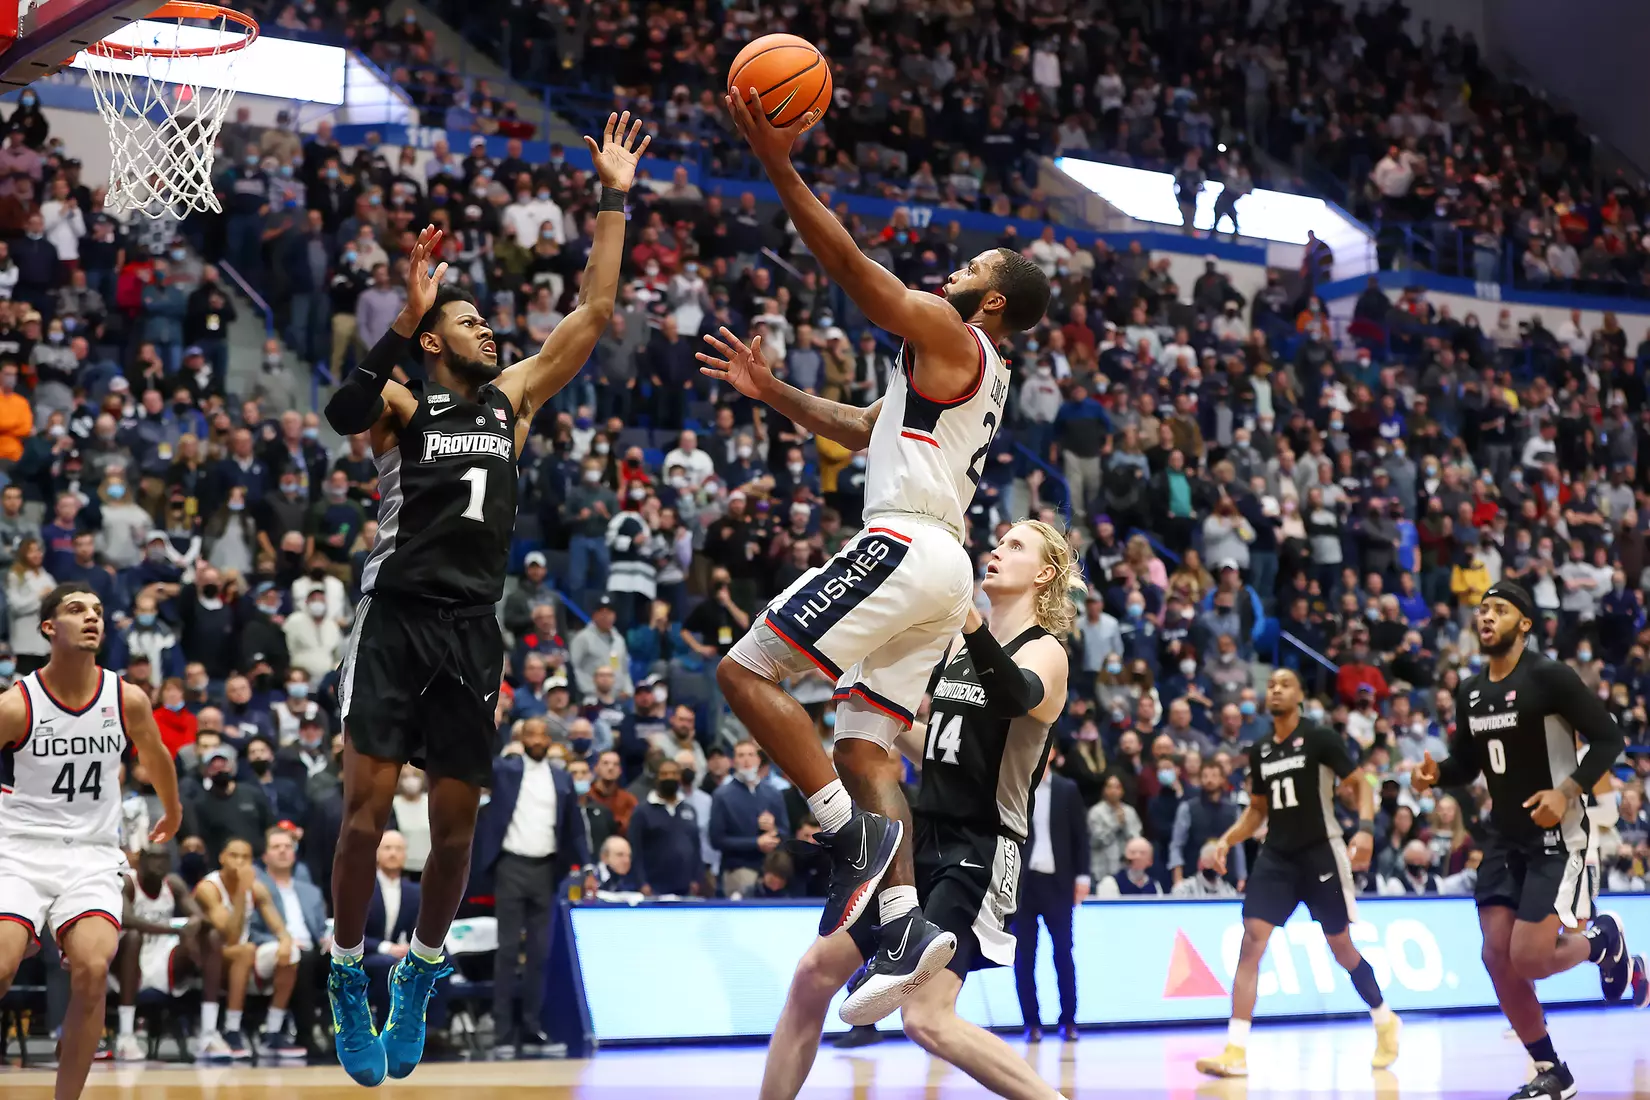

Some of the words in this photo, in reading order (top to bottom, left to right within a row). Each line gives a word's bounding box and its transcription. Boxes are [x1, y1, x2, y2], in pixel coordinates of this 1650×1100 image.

[421, 431, 512, 463] PROVIDENCE
[966, 411, 996, 487] 2
[460, 467, 488, 522] 1
[793, 540, 890, 628] HUSKIES
[926, 711, 963, 765] 14
[1468, 711, 1518, 736] PROVIDENCE
[32, 734, 121, 757] UCONN
[1487, 738, 1506, 774] 0
[51, 761, 102, 802] 44
[1270, 776, 1299, 810] 11
